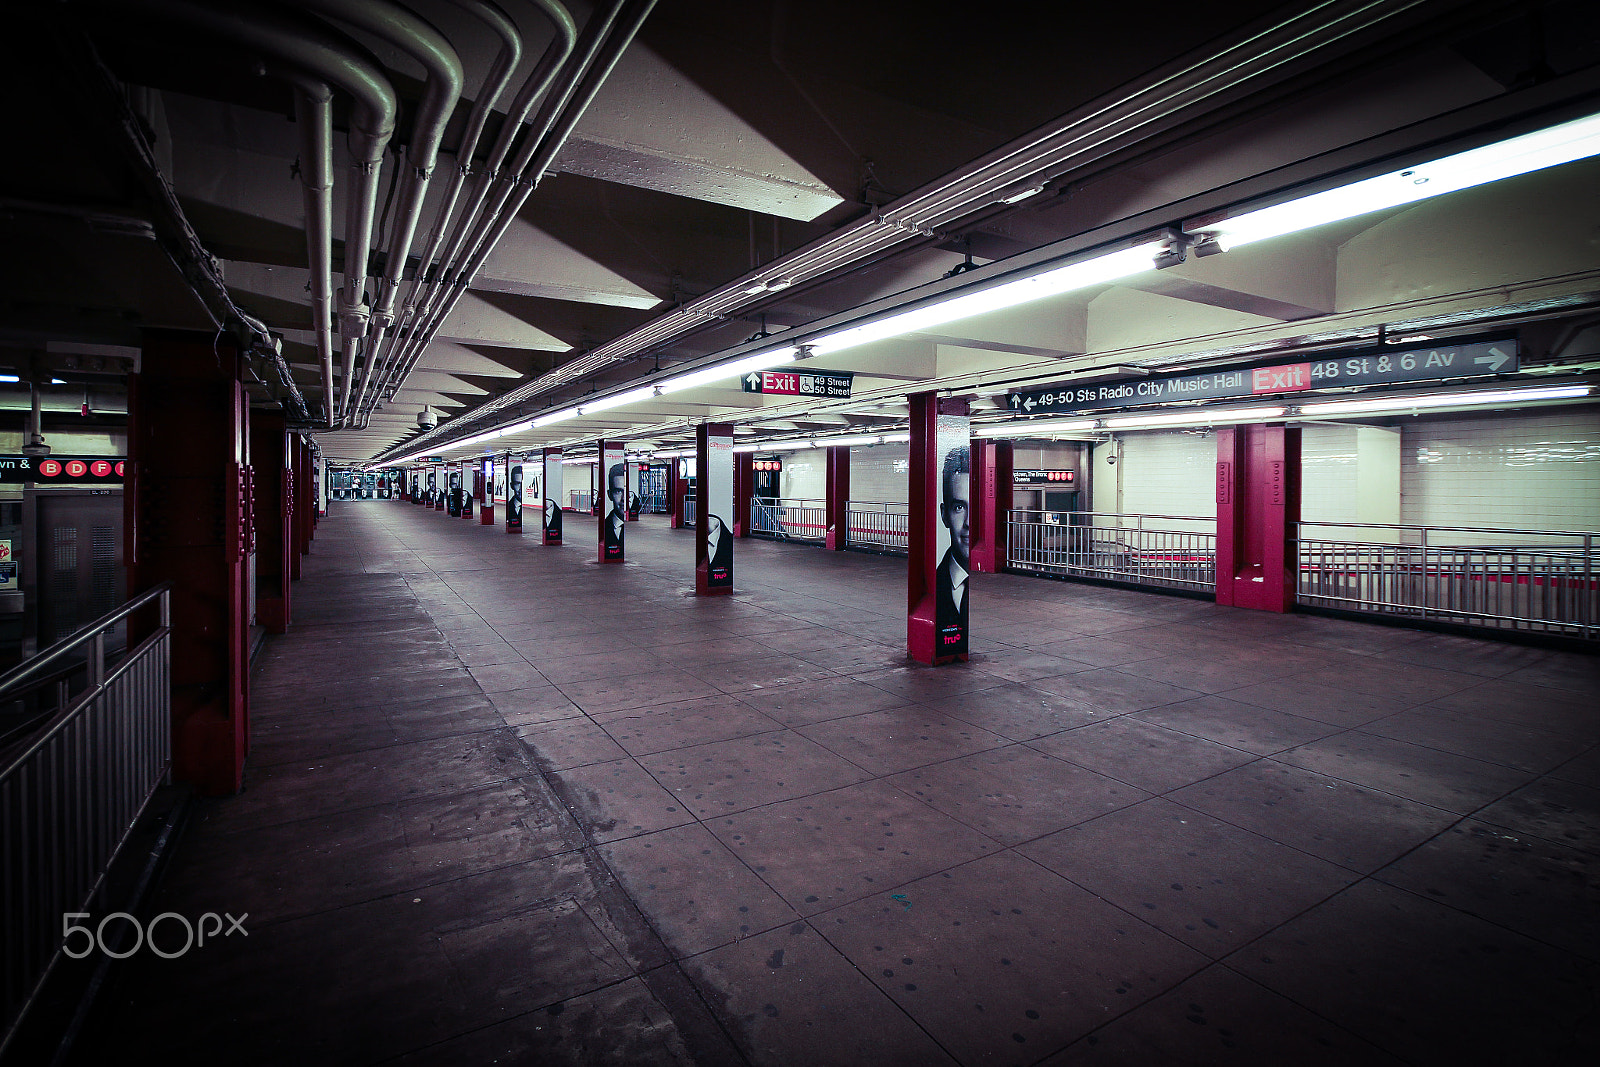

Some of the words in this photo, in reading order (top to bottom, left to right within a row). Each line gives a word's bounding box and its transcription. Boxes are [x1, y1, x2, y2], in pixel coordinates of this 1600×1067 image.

[763, 373, 796, 391] Exit
[814, 376, 825, 385] 49
[827, 377, 850, 387] Street
[1038, 391, 1074, 406] 49-50
[1076, 389, 1096, 402] Sts
[1099, 385, 1134, 400] Radio
[1137, 381, 1164, 397] City
[1168, 376, 1210, 393] Music
[1214, 373, 1242, 389] Hall
[1253, 367, 1303, 390] Exit
[1311, 362, 1340, 379] 48
[1345, 359, 1370, 376] St
[1376, 355, 1392, 373] &
[1400, 353, 1417, 370] 6
[1424, 350, 1455, 368] Av
[814, 385, 825, 394] 50
[827, 386, 850, 396] Street
[20, 459, 31, 469] &
[46, 463, 57, 473] B
[72, 463, 83, 474] D
[97, 463, 107, 473] F
